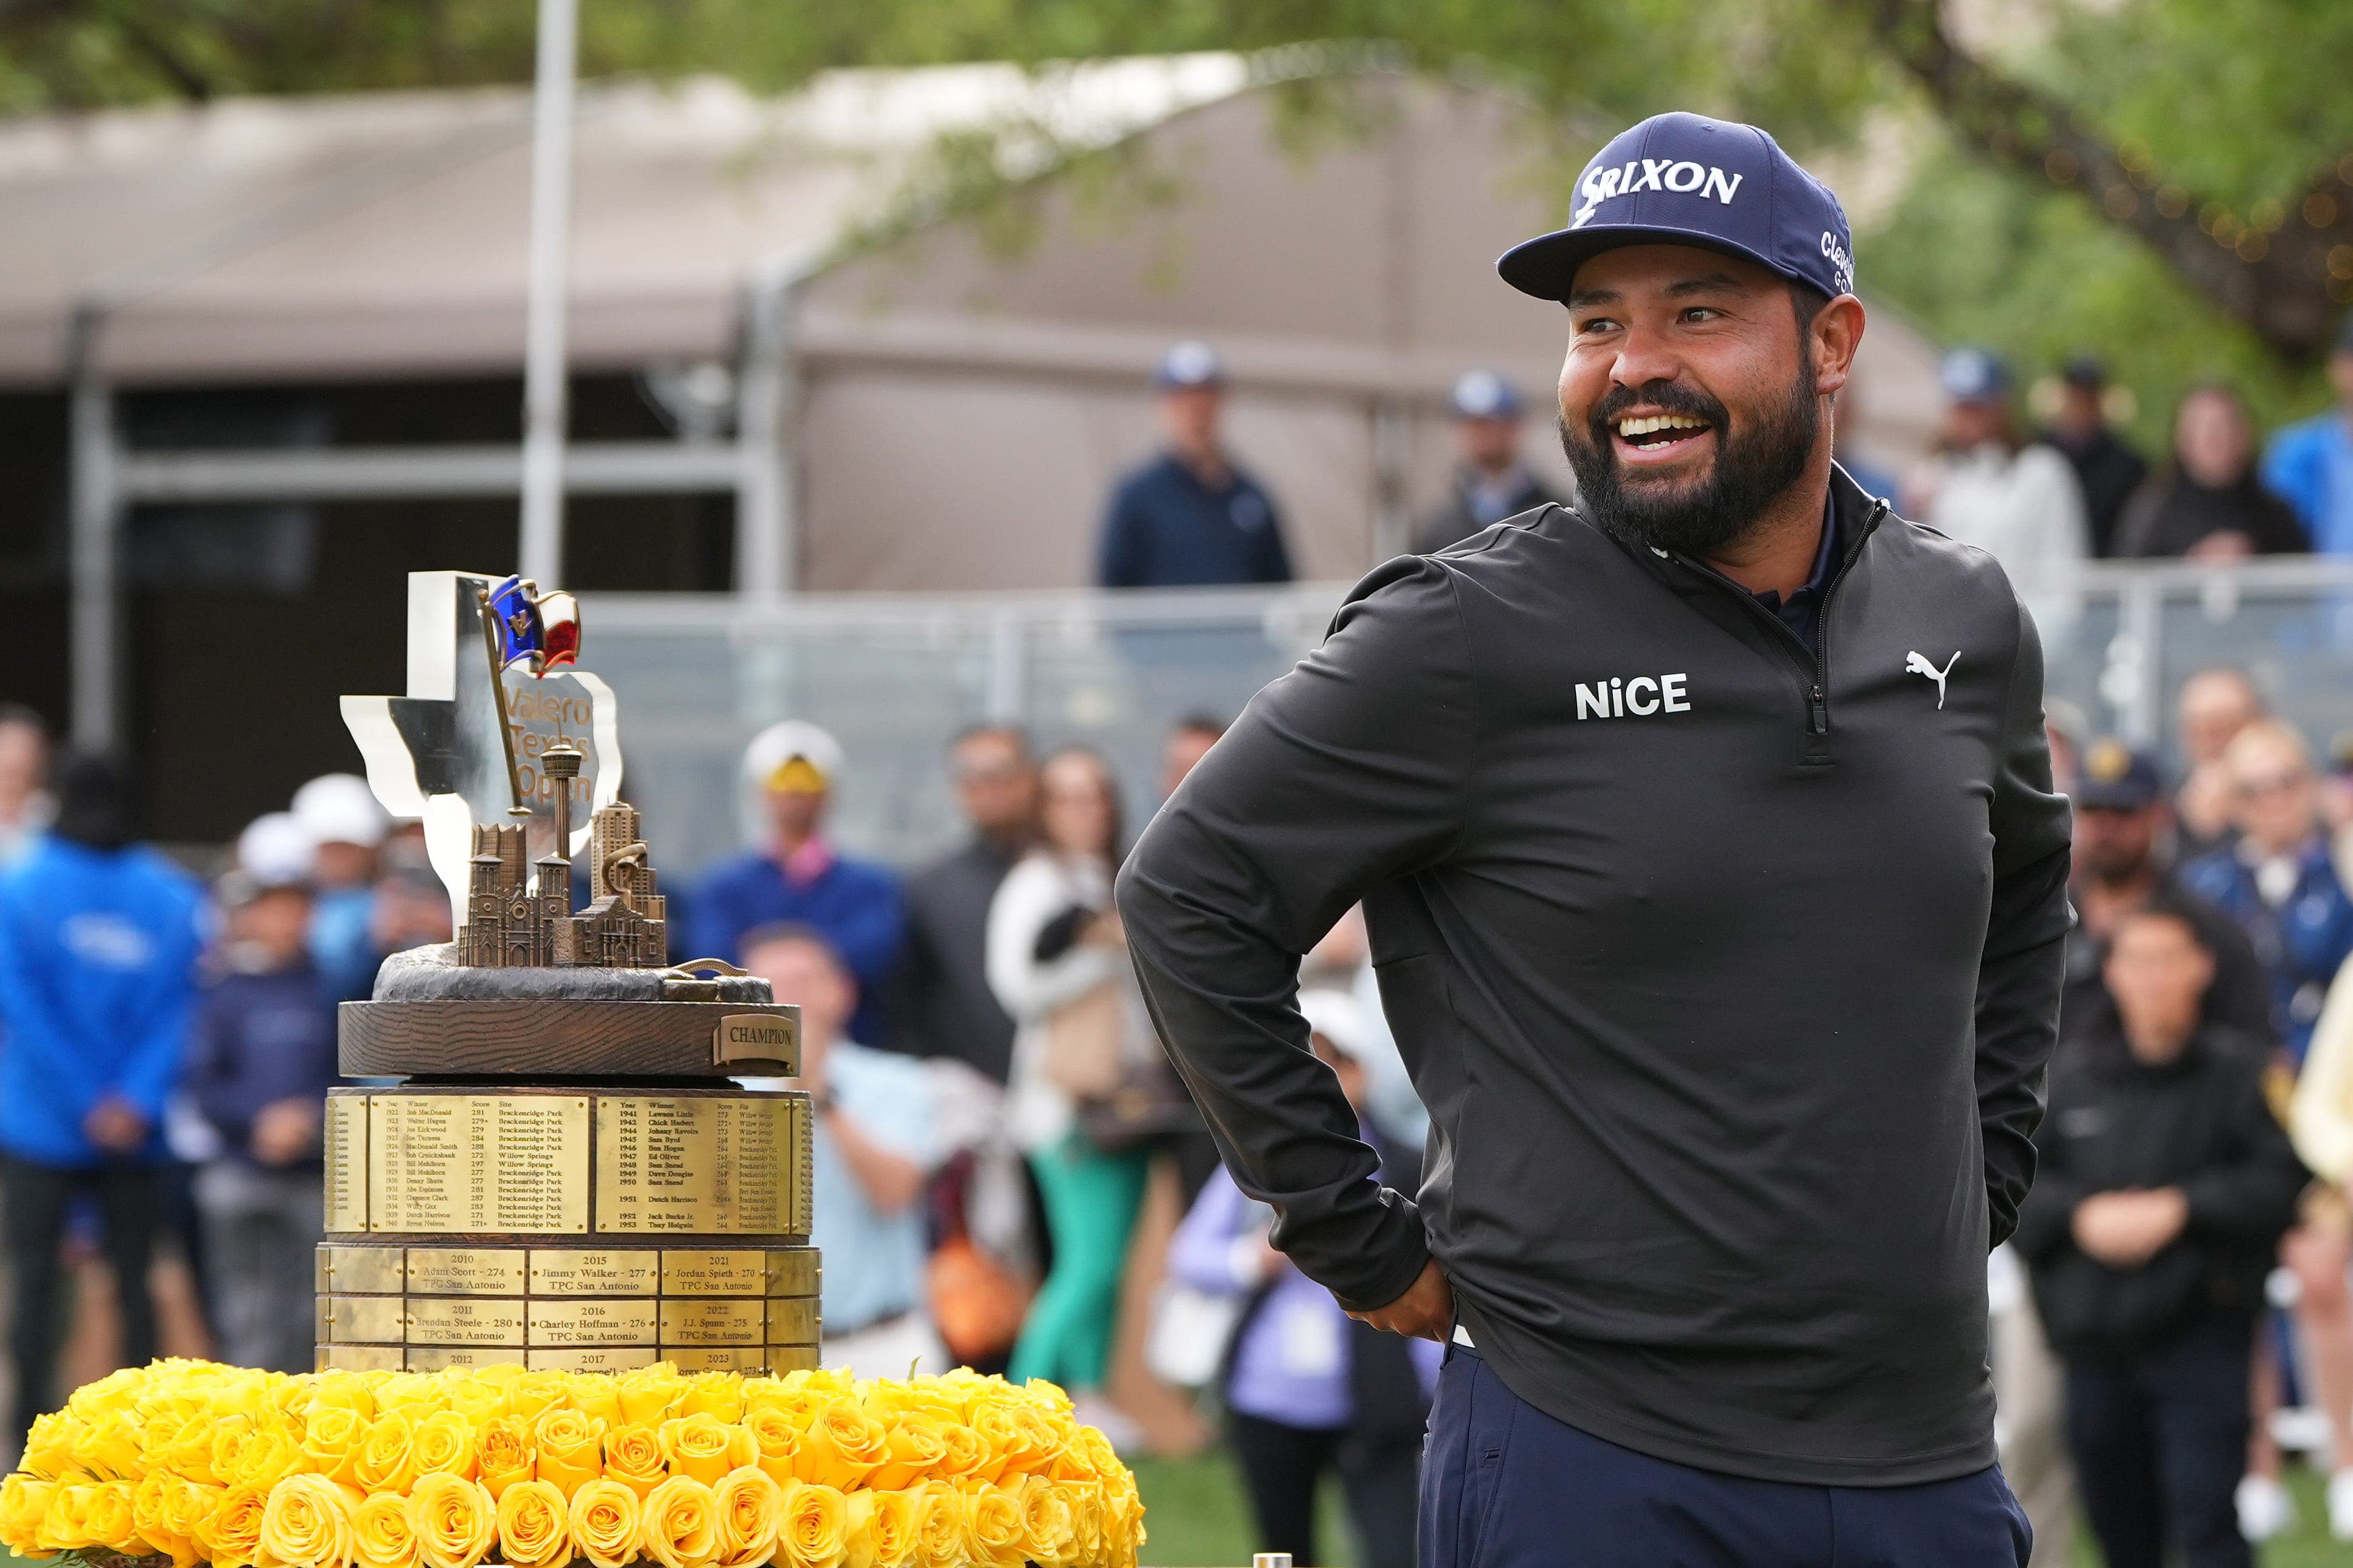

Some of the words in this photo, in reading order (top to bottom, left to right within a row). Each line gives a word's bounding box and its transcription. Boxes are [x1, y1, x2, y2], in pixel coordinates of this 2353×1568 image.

[1571, 159, 1743, 228] SRIXON
[1575, 673, 1691, 720] NiCE
[503, 686, 591, 726] Valero
[516, 763, 591, 804] Opn
[730, 1027, 791, 1046] CHAMPION
[451, 1255, 474, 1264] 2010
[583, 1257, 606, 1265] 2015
[709, 1257, 729, 1265] 2021
[423, 1267, 448, 1276] Adam
[451, 1267, 475, 1276] Scott
[541, 1269, 576, 1277] Jimmy
[580, 1269, 617, 1277] Walker
[708, 1269, 733, 1279] Spieth
[423, 1280, 443, 1288] TPC
[446, 1280, 463, 1289] San
[549, 1282, 573, 1290] TPC
[576, 1282, 595, 1290] San
[680, 1282, 701, 1290] TPC
[704, 1282, 719, 1290] San
[706, 1306, 728, 1314] 2022
[416, 1317, 450, 1326] Brendan
[493, 1319, 513, 1327] 280
[539, 1320, 575, 1329] Charley
[683, 1319, 696, 1327] J.J.
[700, 1319, 725, 1327] Spaun
[734, 1319, 747, 1327] 275
[423, 1330, 443, 1339] TPC
[466, 1331, 504, 1340] Antonio
[548, 1332, 571, 1341] TPC
[576, 1332, 593, 1341] San
[598, 1332, 638, 1341] Antonio
[678, 1331, 699, 1340] TPC
[702, 1331, 718, 1340] San
[720, 1332, 753, 1340] Antonio
[451, 1356, 473, 1364] 2012
[581, 1355, 605, 1364] 2017
